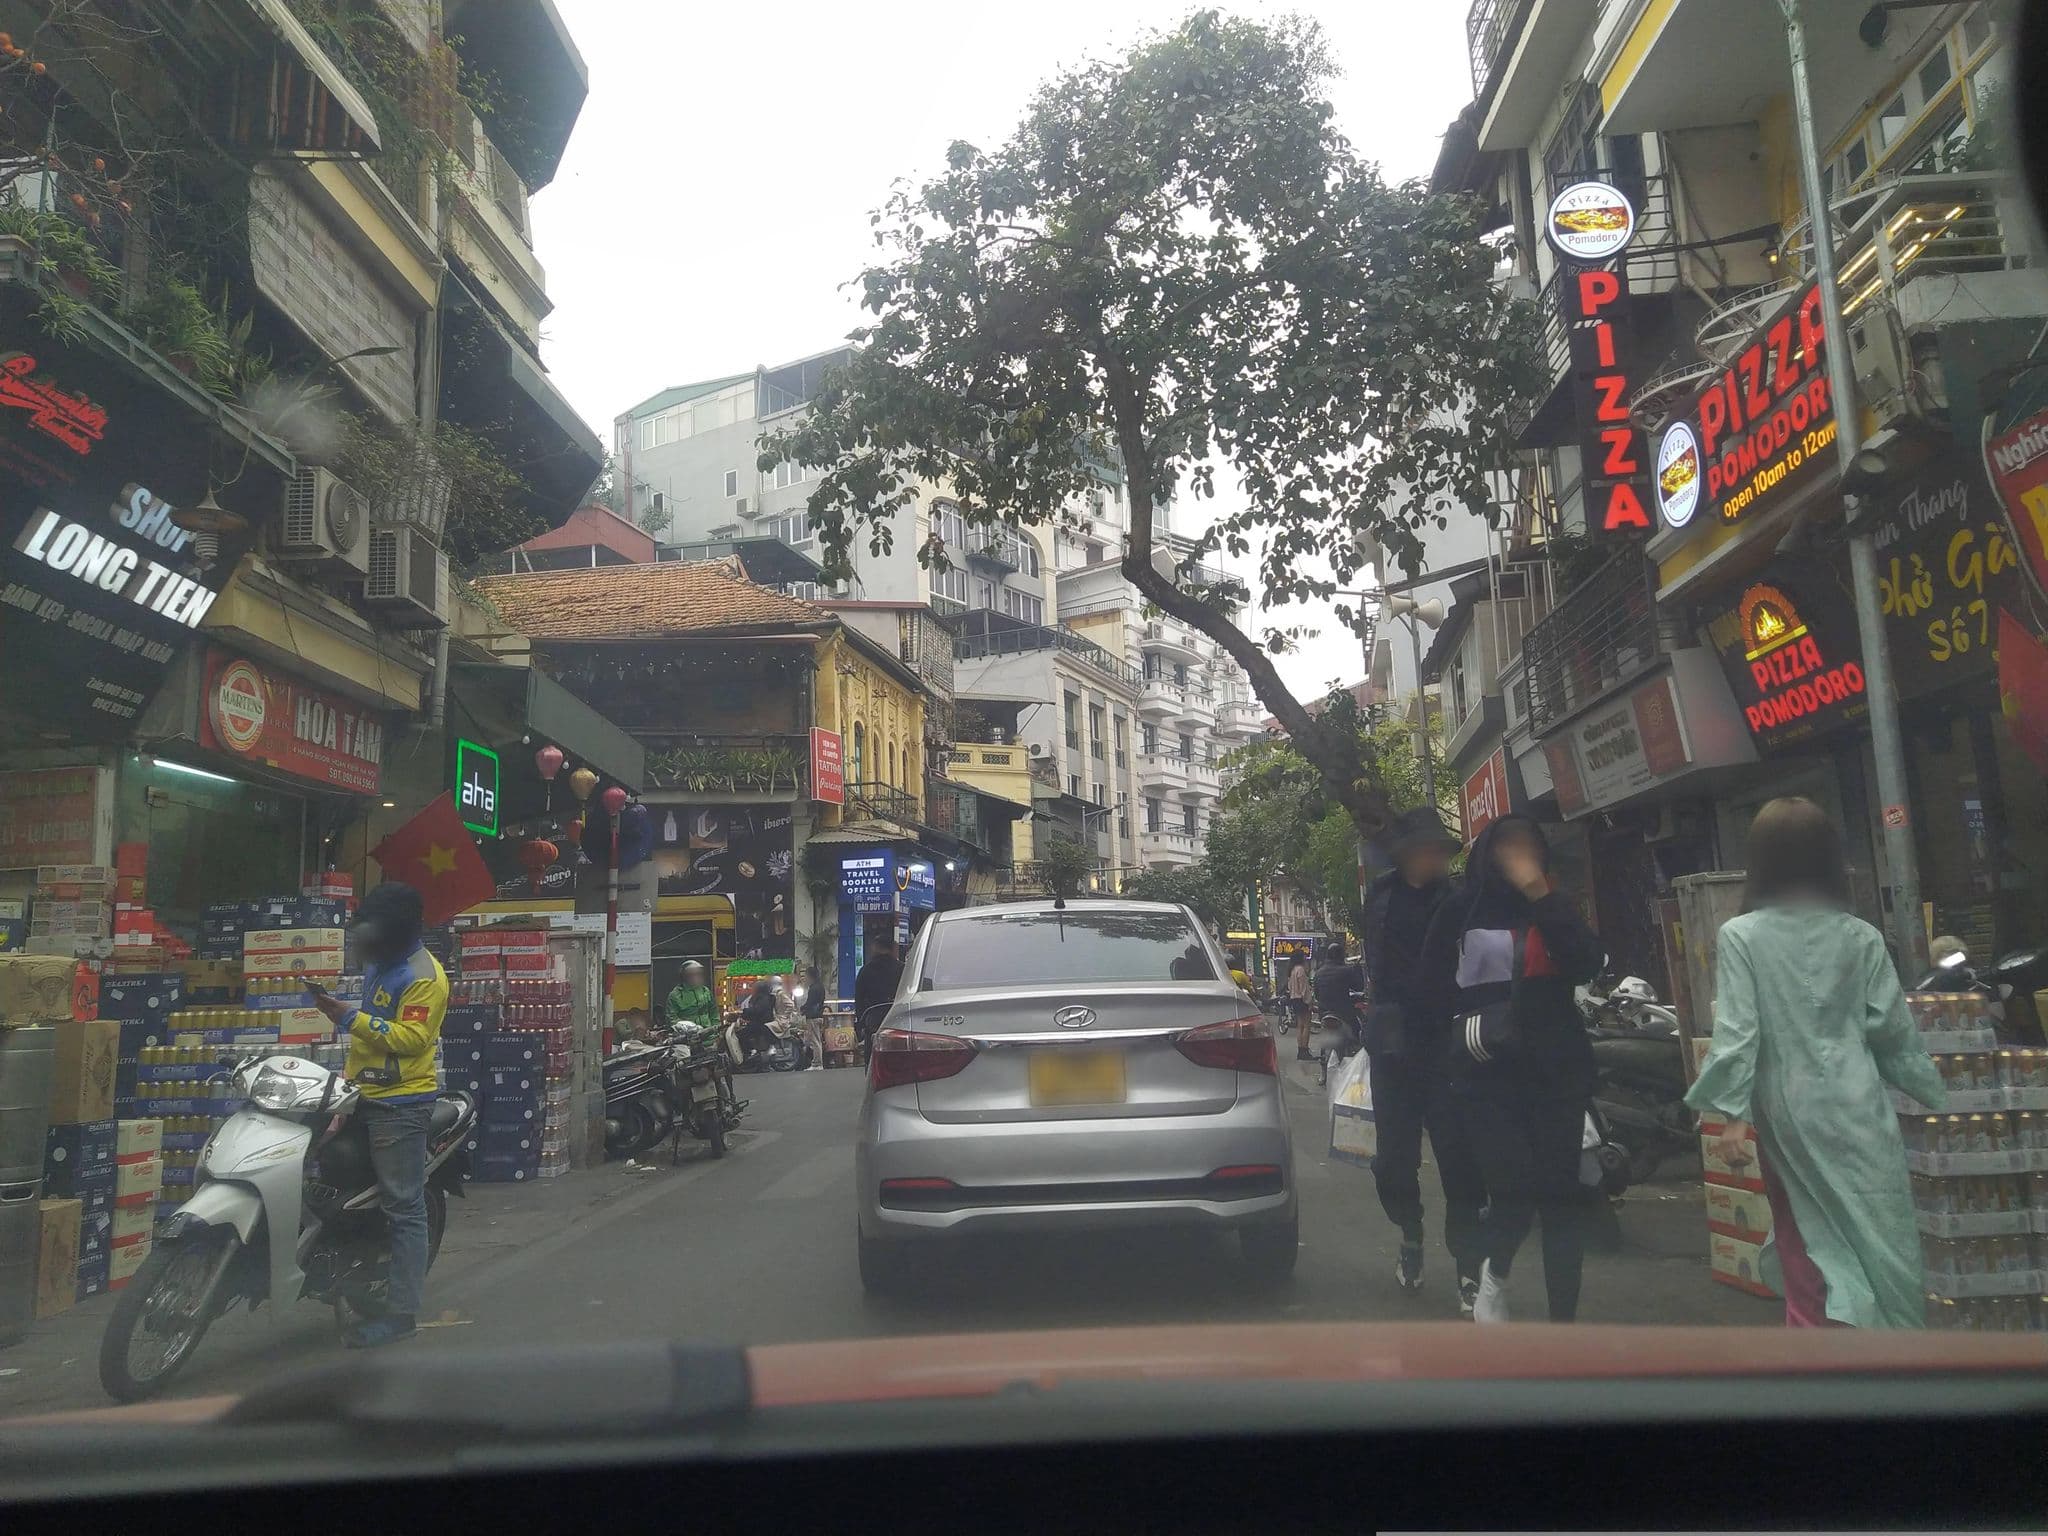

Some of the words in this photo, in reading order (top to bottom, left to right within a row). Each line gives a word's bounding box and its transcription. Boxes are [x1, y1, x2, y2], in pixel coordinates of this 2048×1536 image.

[1568, 195, 1609, 208] Pizza
[1568, 233, 1618, 245] Pomodoro
[1699, 283, 1825, 457] PIZZA
[1579, 271, 1649, 529] PIZZA
[1707, 377, 1834, 499] POMODOR
[1724, 485, 1753, 518] open
[1753, 457, 1787, 497] 10am
[1786, 448, 1802, 469] to
[23, 510, 139, 595] LONG
[133, 560, 218, 629] TIEN
[1948, 521, 2018, 595] Gà
[1968, 599, 1988, 646] 7
[1751, 634, 1823, 694] PIZZA
[1745, 661, 1866, 733] POMODORO
[462, 771, 495, 811] aha
[842, 878, 885, 886] BOOKING
[846, 870, 880, 878] TRAVEL
[856, 859, 872, 867] ATM
[847, 886, 881, 895] OFFICE
